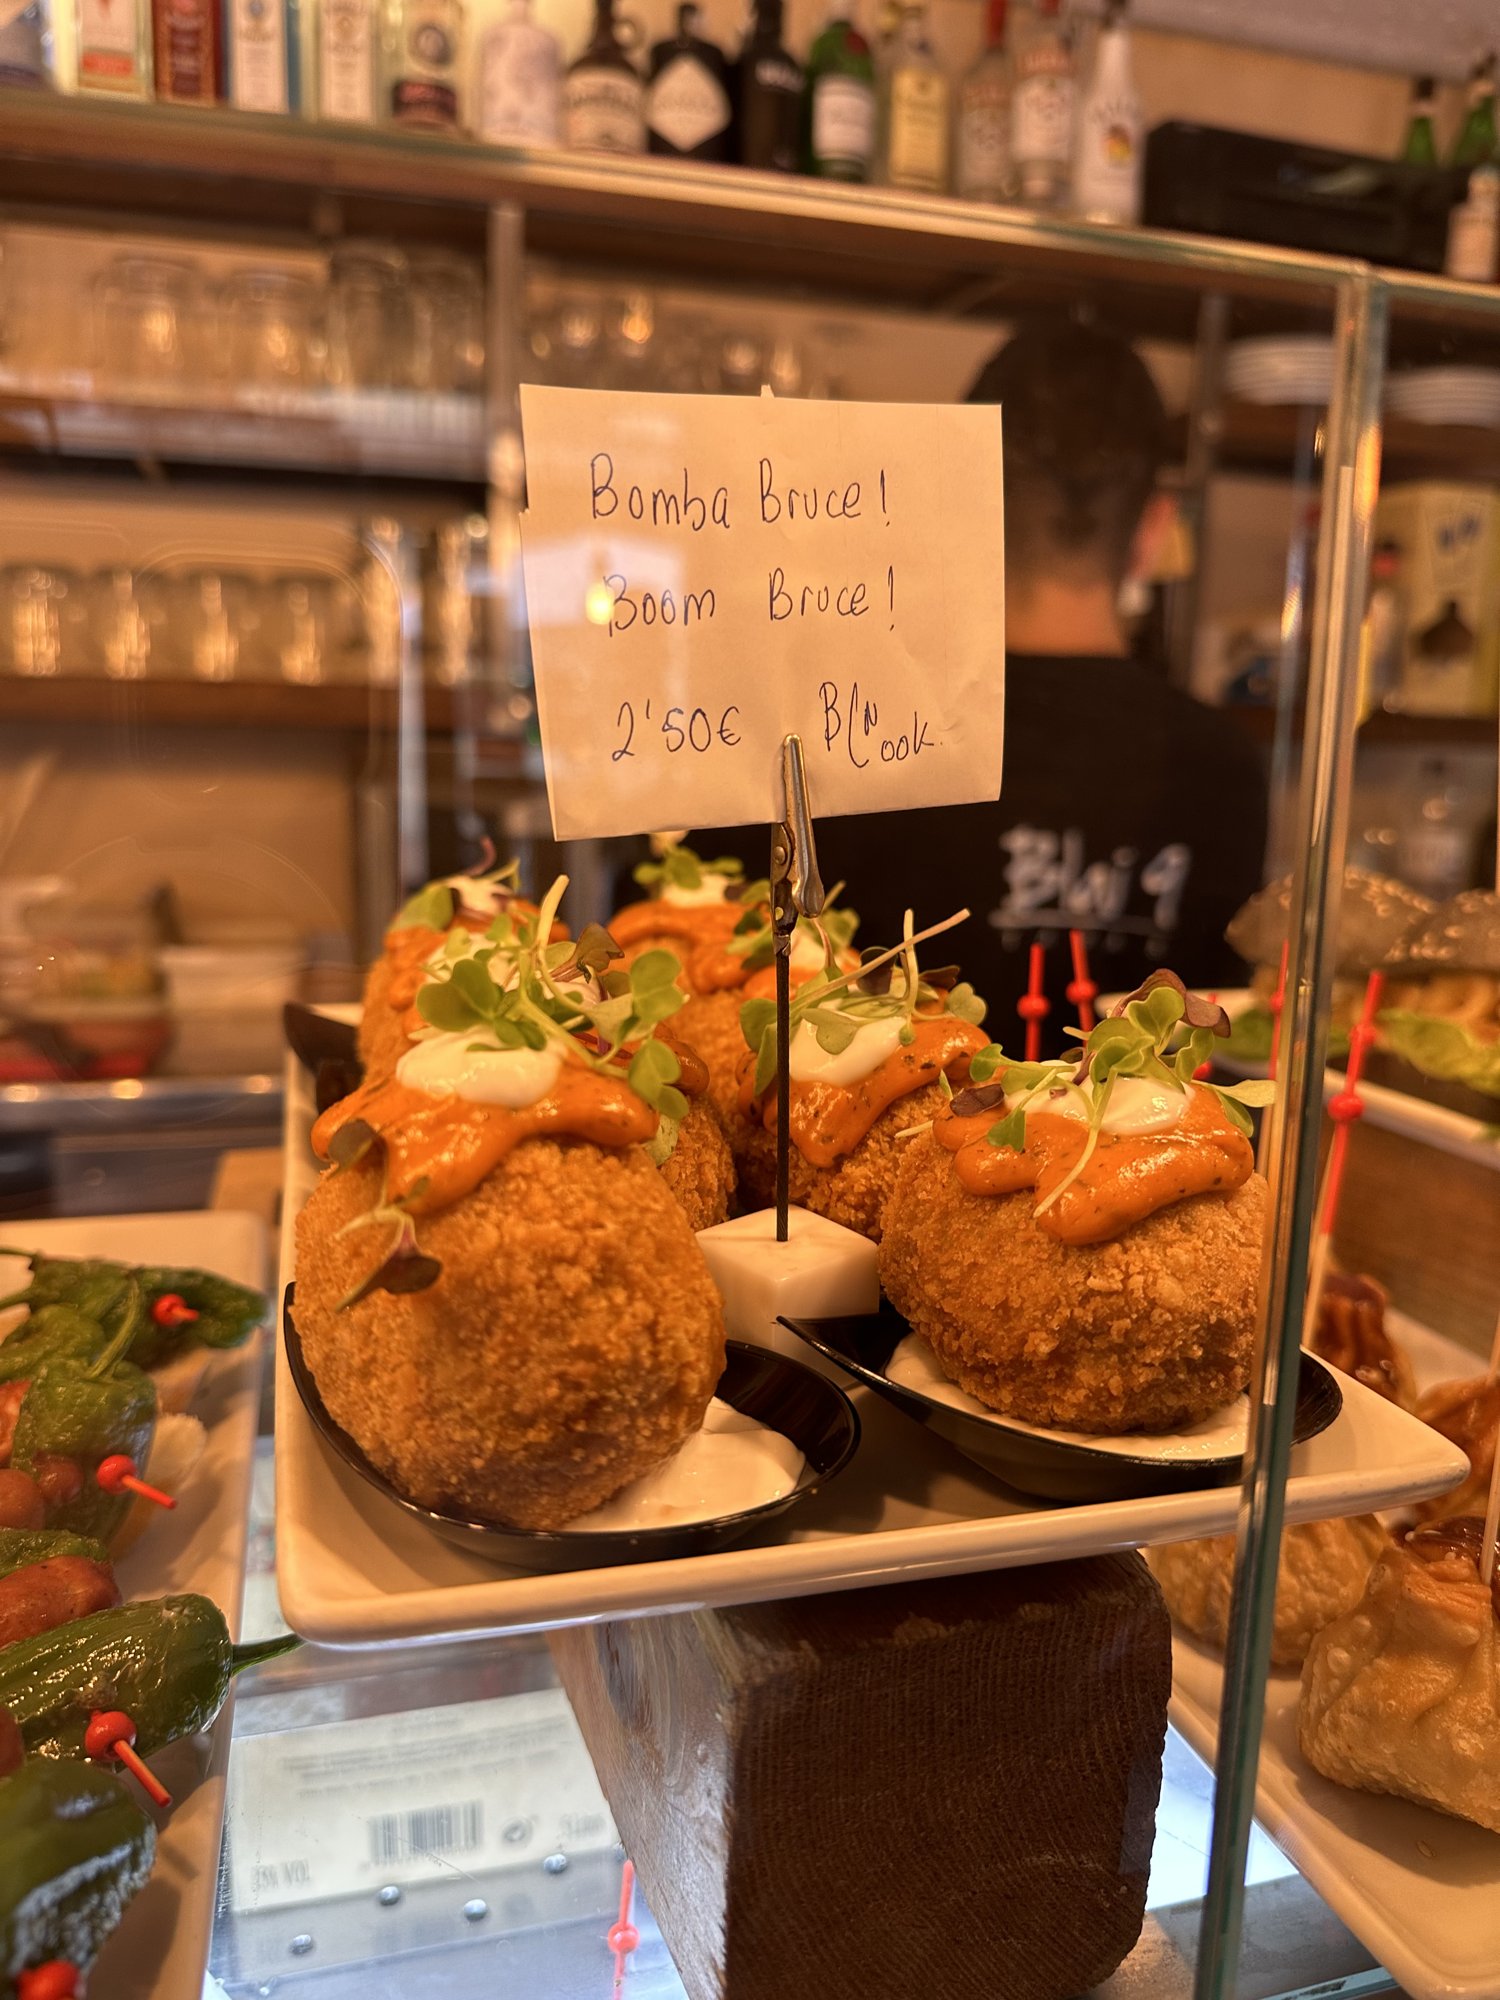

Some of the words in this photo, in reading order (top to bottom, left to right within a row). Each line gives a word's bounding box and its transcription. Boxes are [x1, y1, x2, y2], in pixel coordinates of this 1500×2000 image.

[589, 452, 731, 531] Bomba
[758, 457, 891, 527] Bruce!
[602, 573, 716, 638] Boom
[768, 564, 896, 632] Bruce!
[610, 698, 742, 762] 2'50€
[999, 823, 1137, 921] Blai
